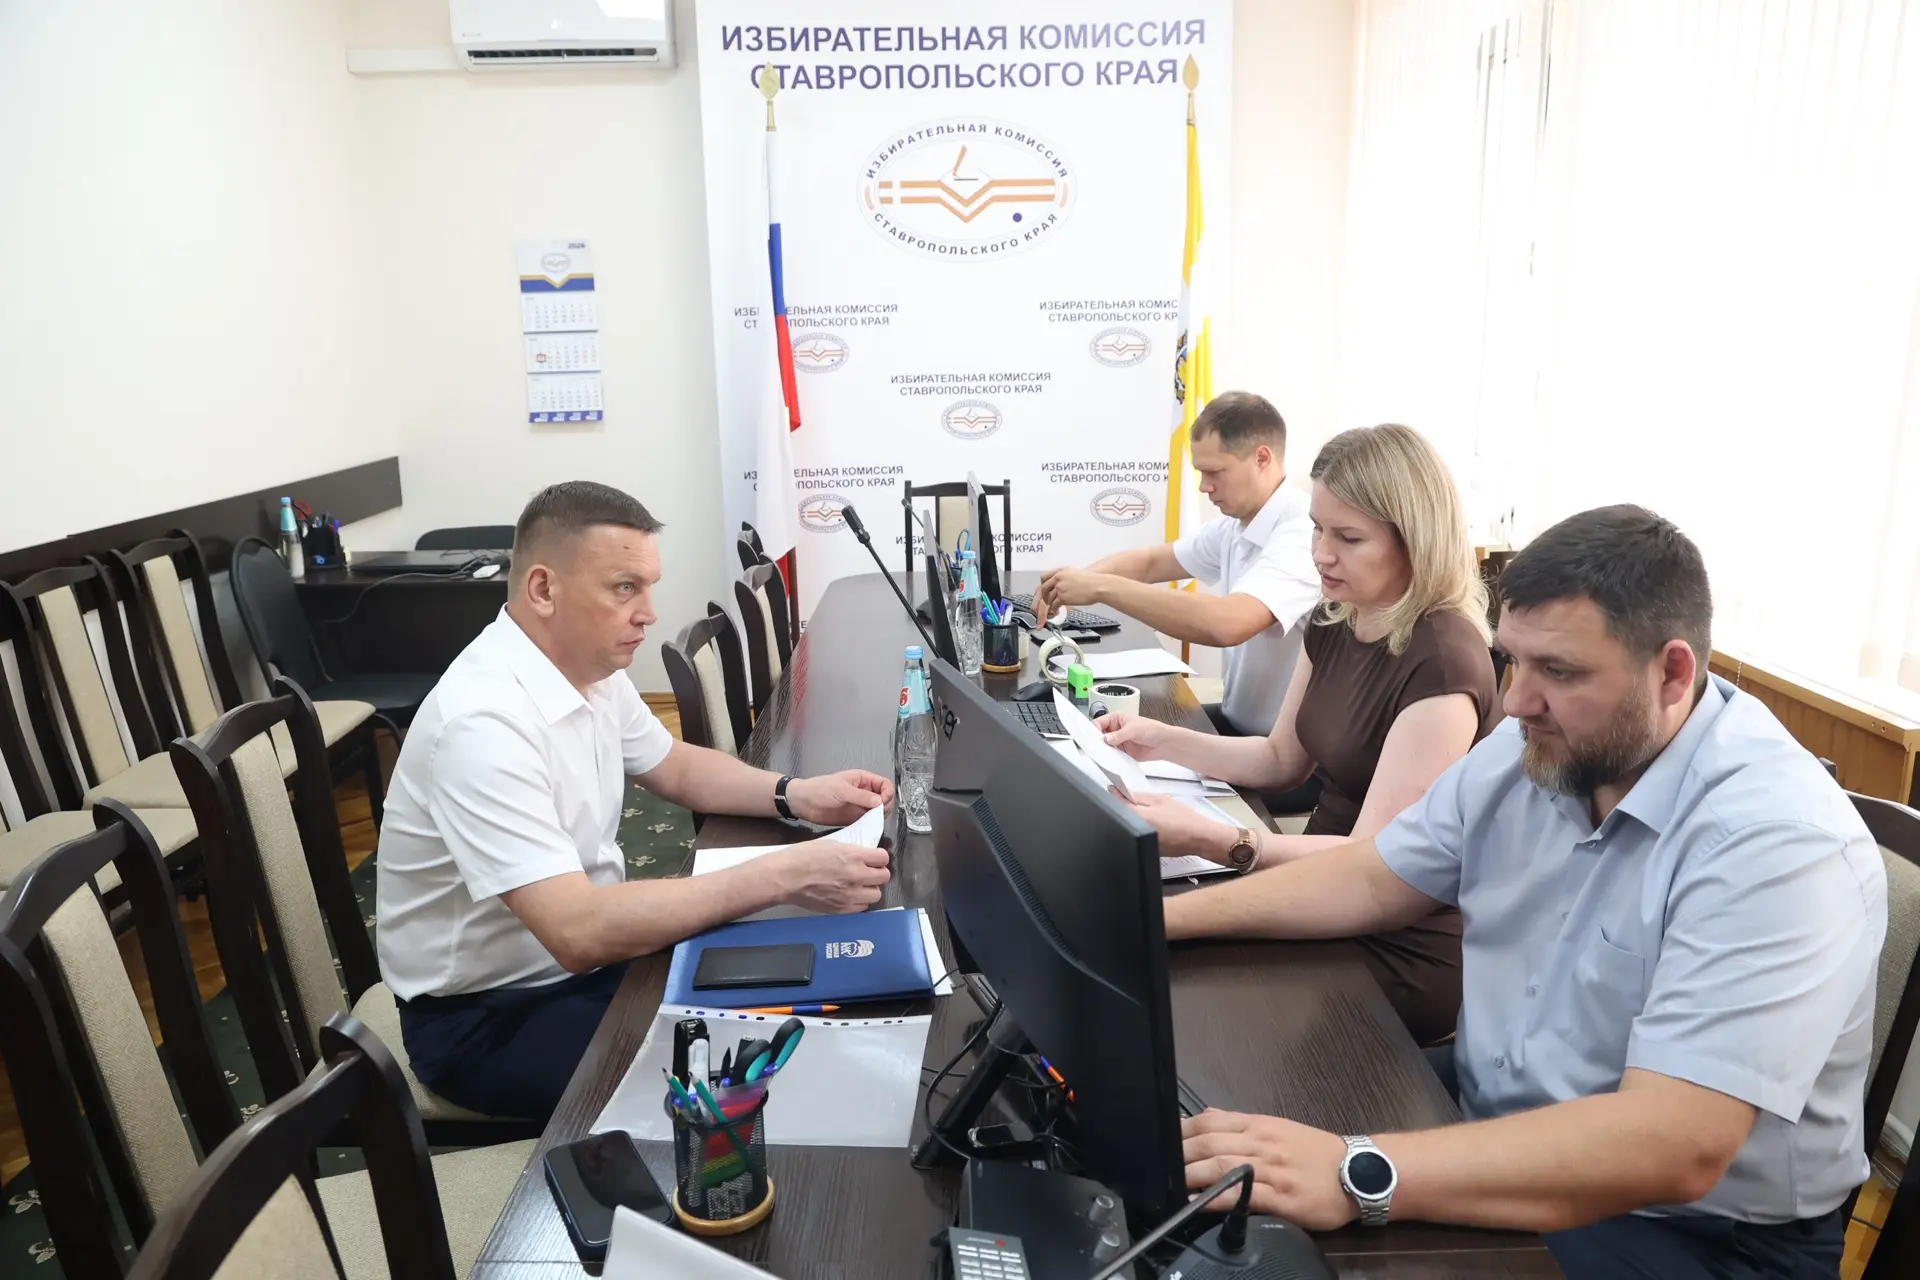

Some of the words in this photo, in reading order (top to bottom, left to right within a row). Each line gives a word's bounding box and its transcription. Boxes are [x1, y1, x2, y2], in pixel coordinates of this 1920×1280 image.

[721, 25, 1007, 52] ИЗБИРАТЕЛЬНАЯ
[1019, 18, 1206, 50] КОМИССИЯ
[750, 63, 1084, 90] СТАВРОПОЛЬСКОГО
[1096, 59, 1178, 86] КРАЯ
[866, 123, 988, 180] ИЗБИРАТЕЛЬНАЯ
[994, 125, 1068, 179] КОМИССИЯ
[873, 213, 1019, 256] СТАВРОПОЛЬСКОГО
[1024, 213, 1058, 242] КРАЯ
[734, 305, 832, 317] ИЗБЕЛЬНАЯ
[835, 303, 898, 315] КОМИССИЯ
[1039, 300, 1136, 311] ИЗБИРАТЕЛЬНАЯ
[1138, 299, 1179, 309] КОМИС
[743, 316, 858, 329] СТПОЛЬСКОГО
[860, 316, 890, 327] КРАЯ
[1048, 311, 1162, 323] СТАВРОПОЛЬСКОГО
[1164, 311, 1179, 321] КР
[890, 373, 986, 384] ИЗБИРАТЕЛЬНАЯ
[989, 372, 1051, 383] КОМИССИЯ
[899, 385, 1012, 396] СТАВРОПОЛЬСКОГО
[1014, 384, 1043, 394] КРАЯ
[1041, 461, 1136, 472] ИЗБИРАТЕЛЬНАЯ
[1138, 461, 1170, 471] КОМИ
[743, 467, 840, 481] ИЗЕЛЬНАЯ
[841, 465, 904, 477] КОМИССИЯ
[1050, 473, 1161, 483] СТАВРОПОЛЬСКОГО
[867, 477, 896, 488] КРАЯ
[1016, 544, 1044, 554] КРАЯ
